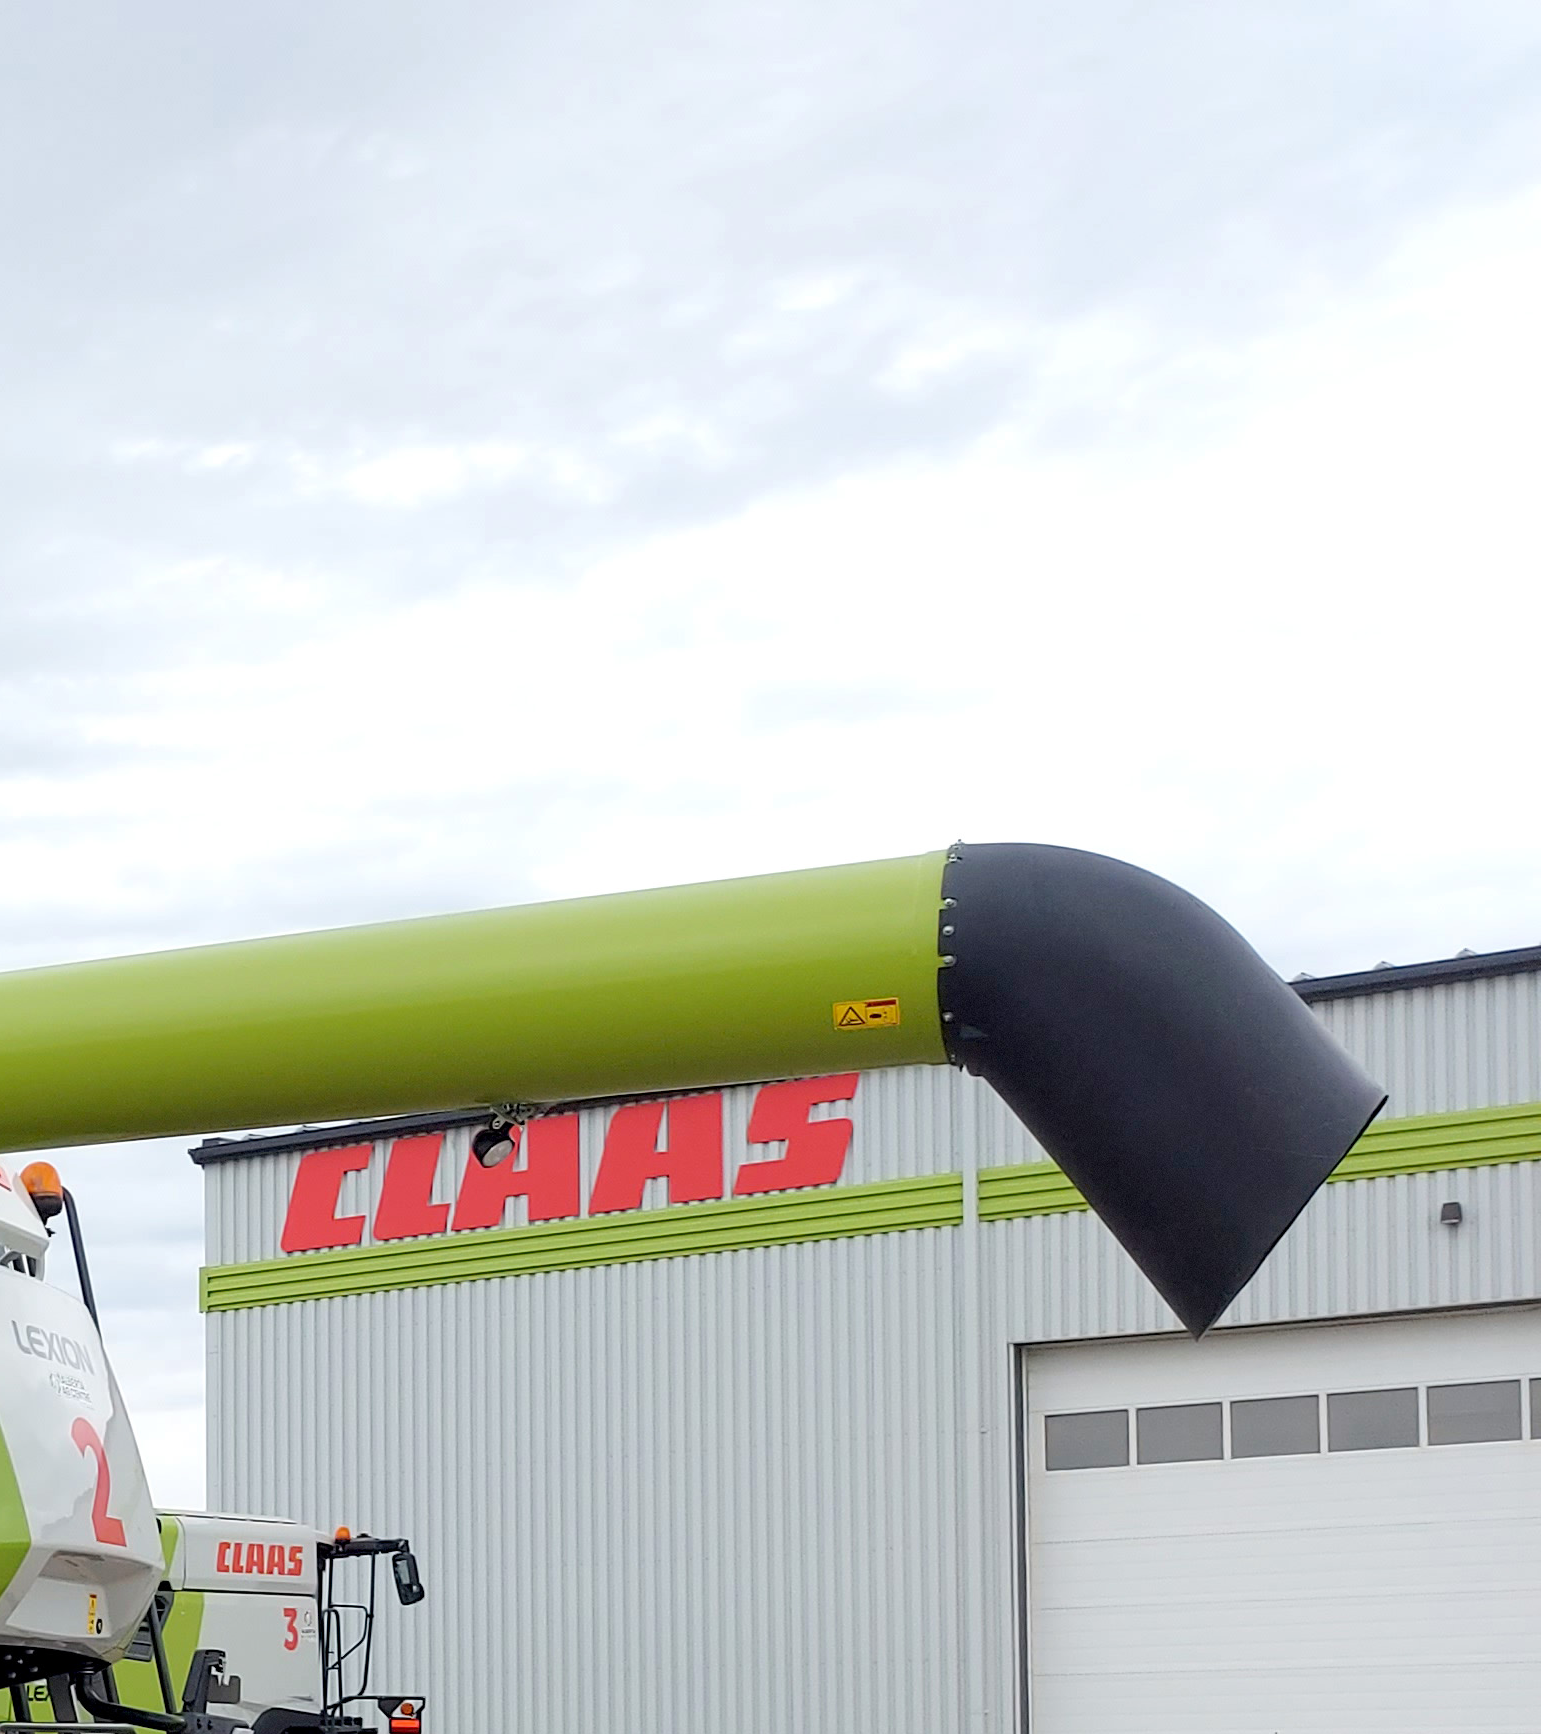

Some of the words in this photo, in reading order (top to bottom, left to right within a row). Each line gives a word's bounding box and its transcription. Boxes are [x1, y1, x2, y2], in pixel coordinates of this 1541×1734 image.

[280, 1072, 860, 1252] CLAAS
[10, 1319, 95, 1376] LEXION
[70, 1416, 127, 1548] 2
[216, 1541, 304, 1577] CLAAS
[282, 1607, 299, 1651] 3
